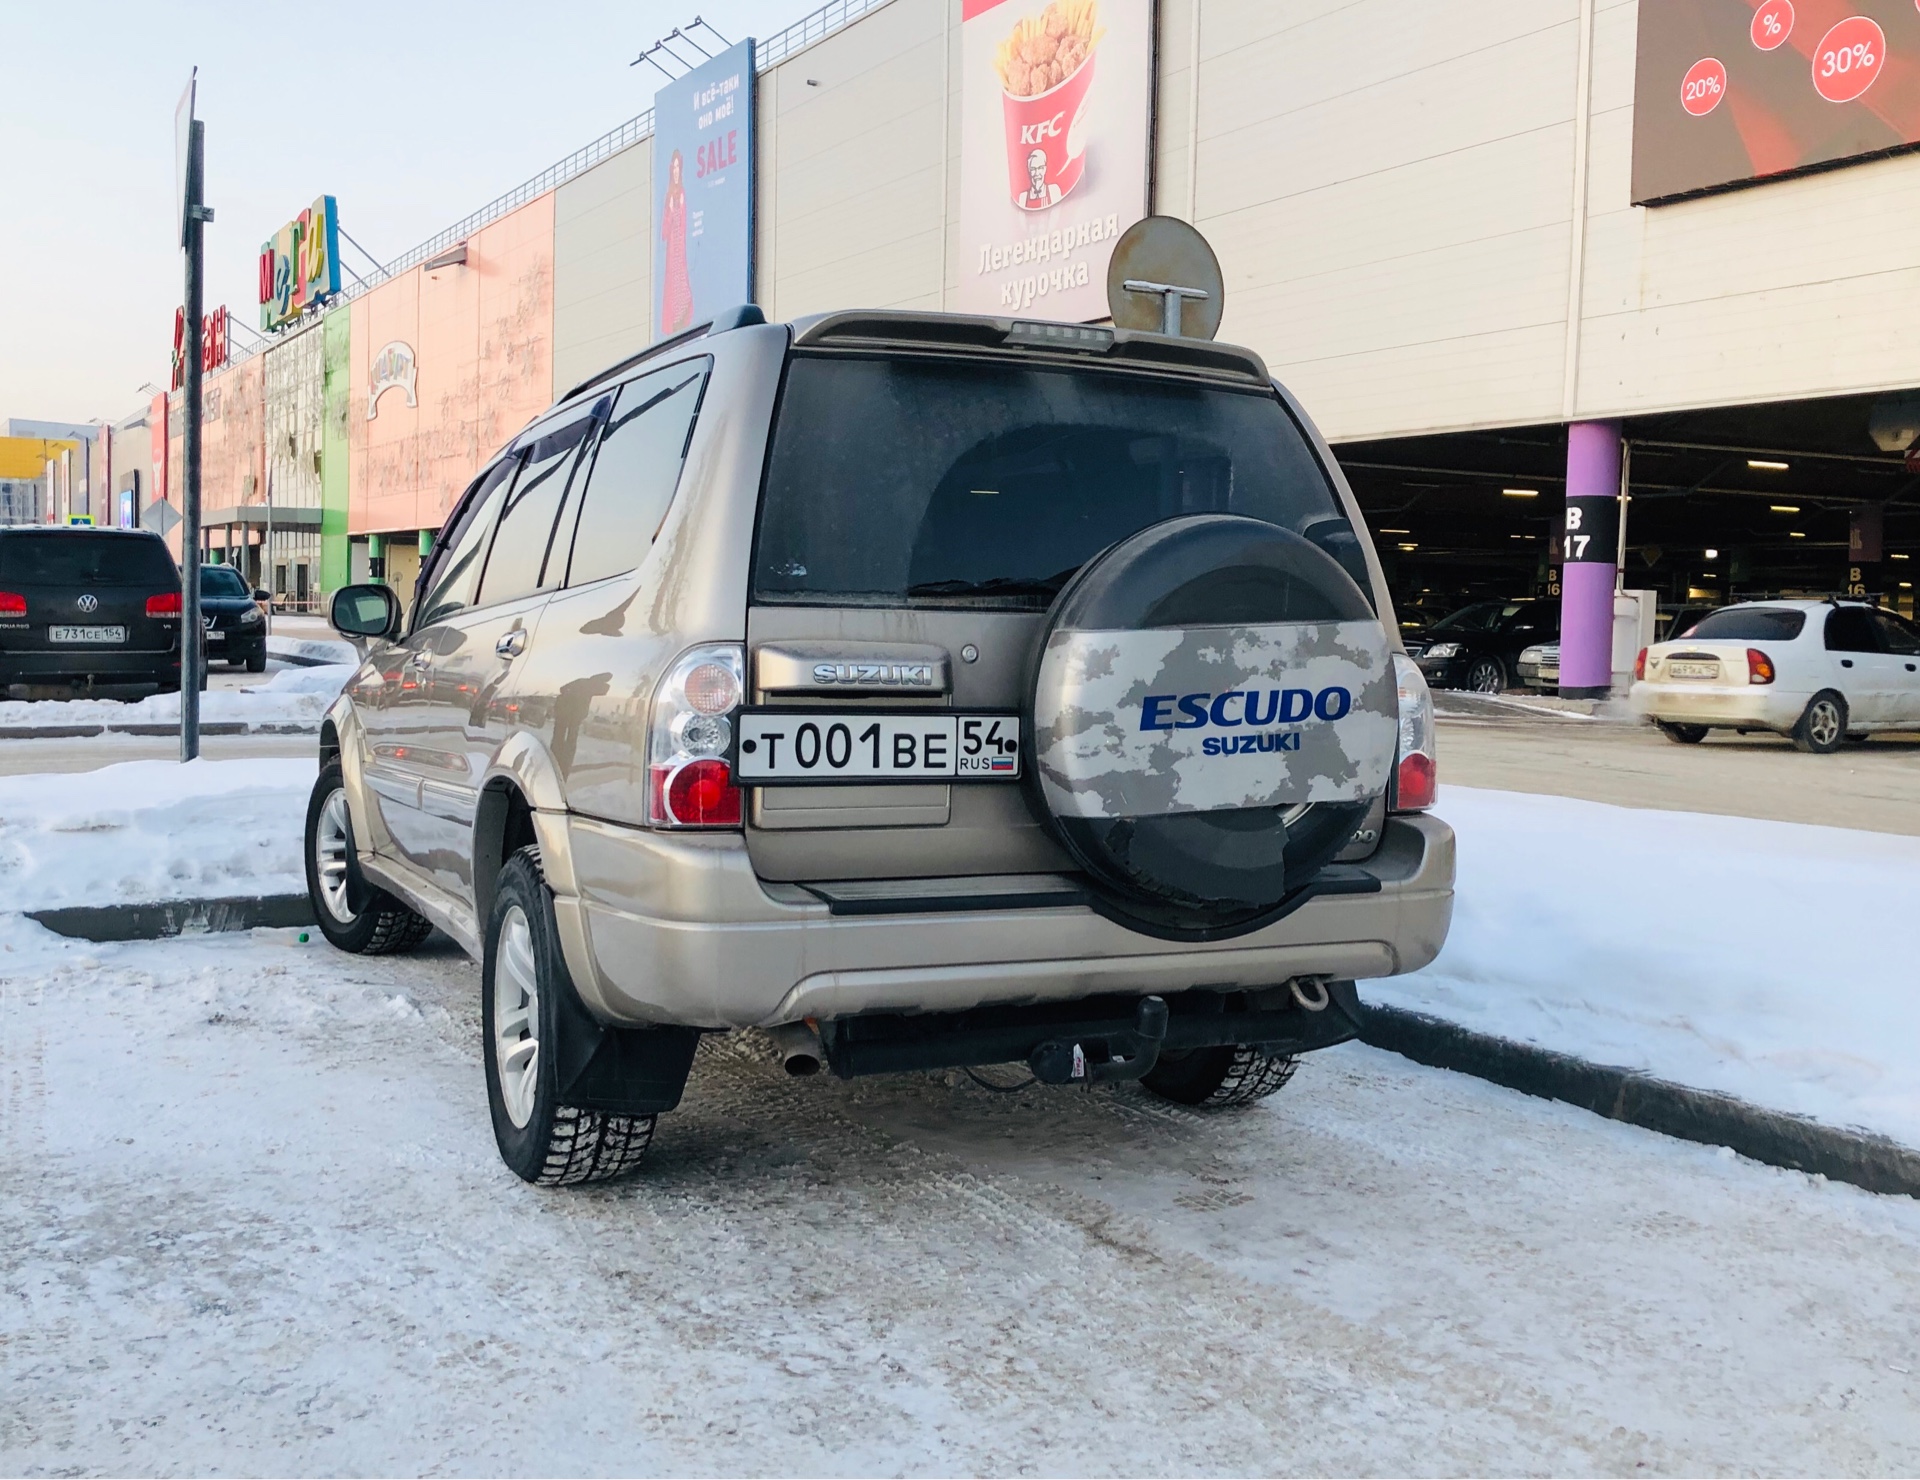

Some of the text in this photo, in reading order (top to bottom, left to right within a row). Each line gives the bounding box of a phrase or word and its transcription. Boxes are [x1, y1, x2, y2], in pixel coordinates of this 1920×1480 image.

[1763, 11, 1781, 36] %
[1821, 41, 1875, 77] 30%
[693, 73, 740, 111] И всё-таки
[1685, 75, 1721, 100] 20%
[698, 94, 734, 130] оно моё!
[1020, 111, 1066, 145] KFC
[696, 129, 738, 179] SALE
[978, 212, 1120, 276] Легендарная
[1001, 260, 1090, 312] курочка
[1566, 507, 1583, 530] B
[1563, 535, 1591, 560] 17
[103, 628, 121, 637] 154
[813, 663, 933, 686] SUZUKI
[1139, 686, 1352, 732] ESCUDO
[963, 720, 1004, 756] 54
[1202, 732, 1301, 756] SUZUKI
[959, 757, 990, 770] RUS
